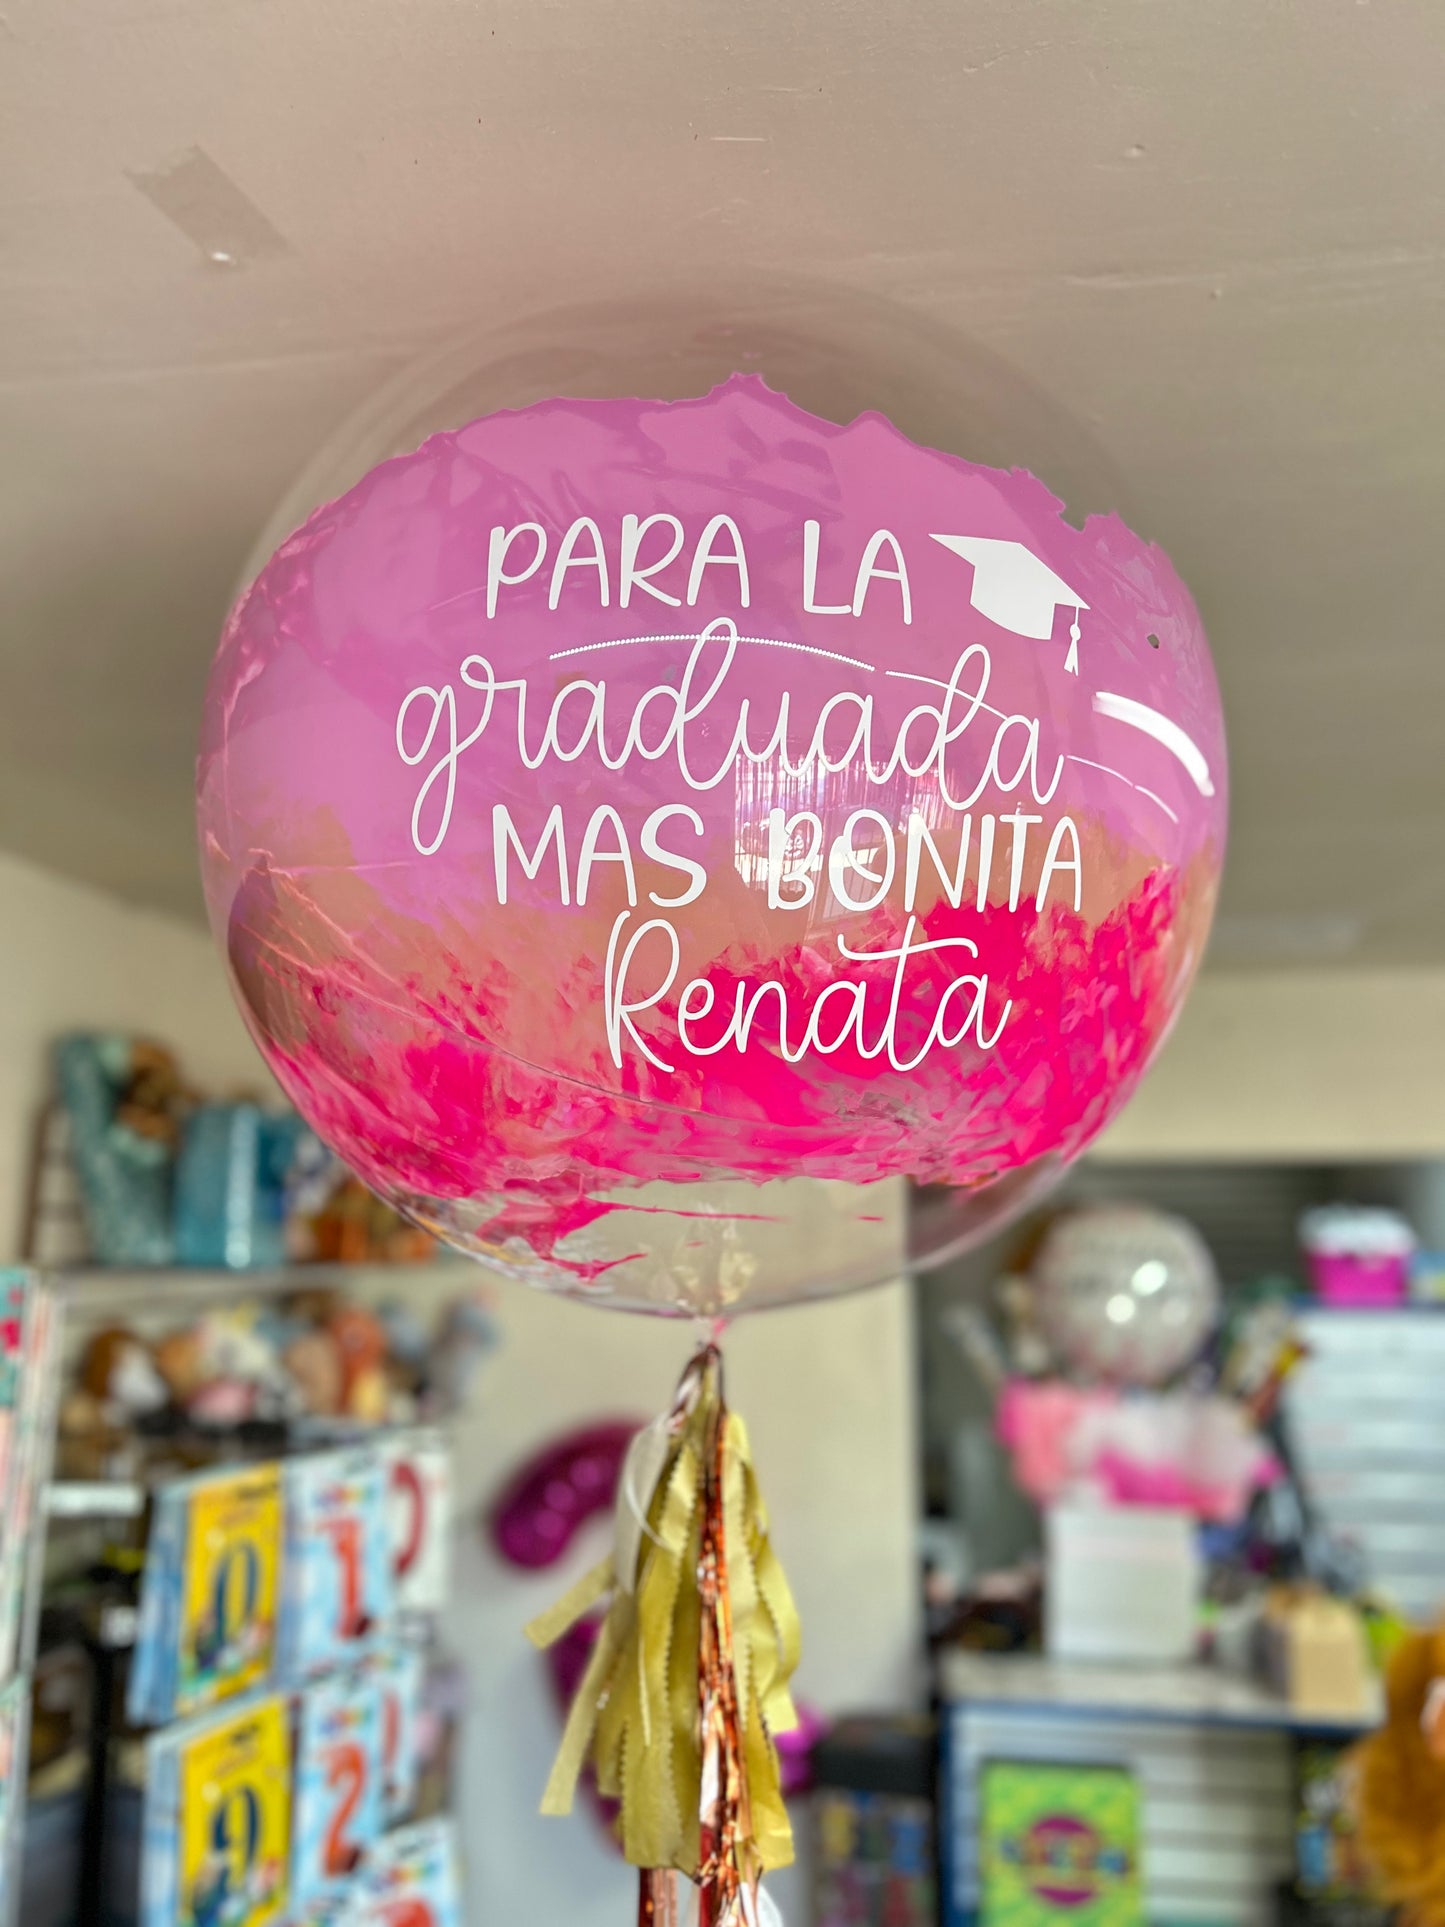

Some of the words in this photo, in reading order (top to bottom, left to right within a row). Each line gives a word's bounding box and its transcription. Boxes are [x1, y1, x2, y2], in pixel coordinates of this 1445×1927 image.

[486, 513, 750, 619] PARA
[802, 519, 913, 625] LA
[396, 617, 1064, 855] graduada
[492, 804, 708, 907] MAS
[767, 804, 1082, 913] BONITA
[604, 910, 1013, 1073] Renata
[320, 1742, 368, 1880] 2
